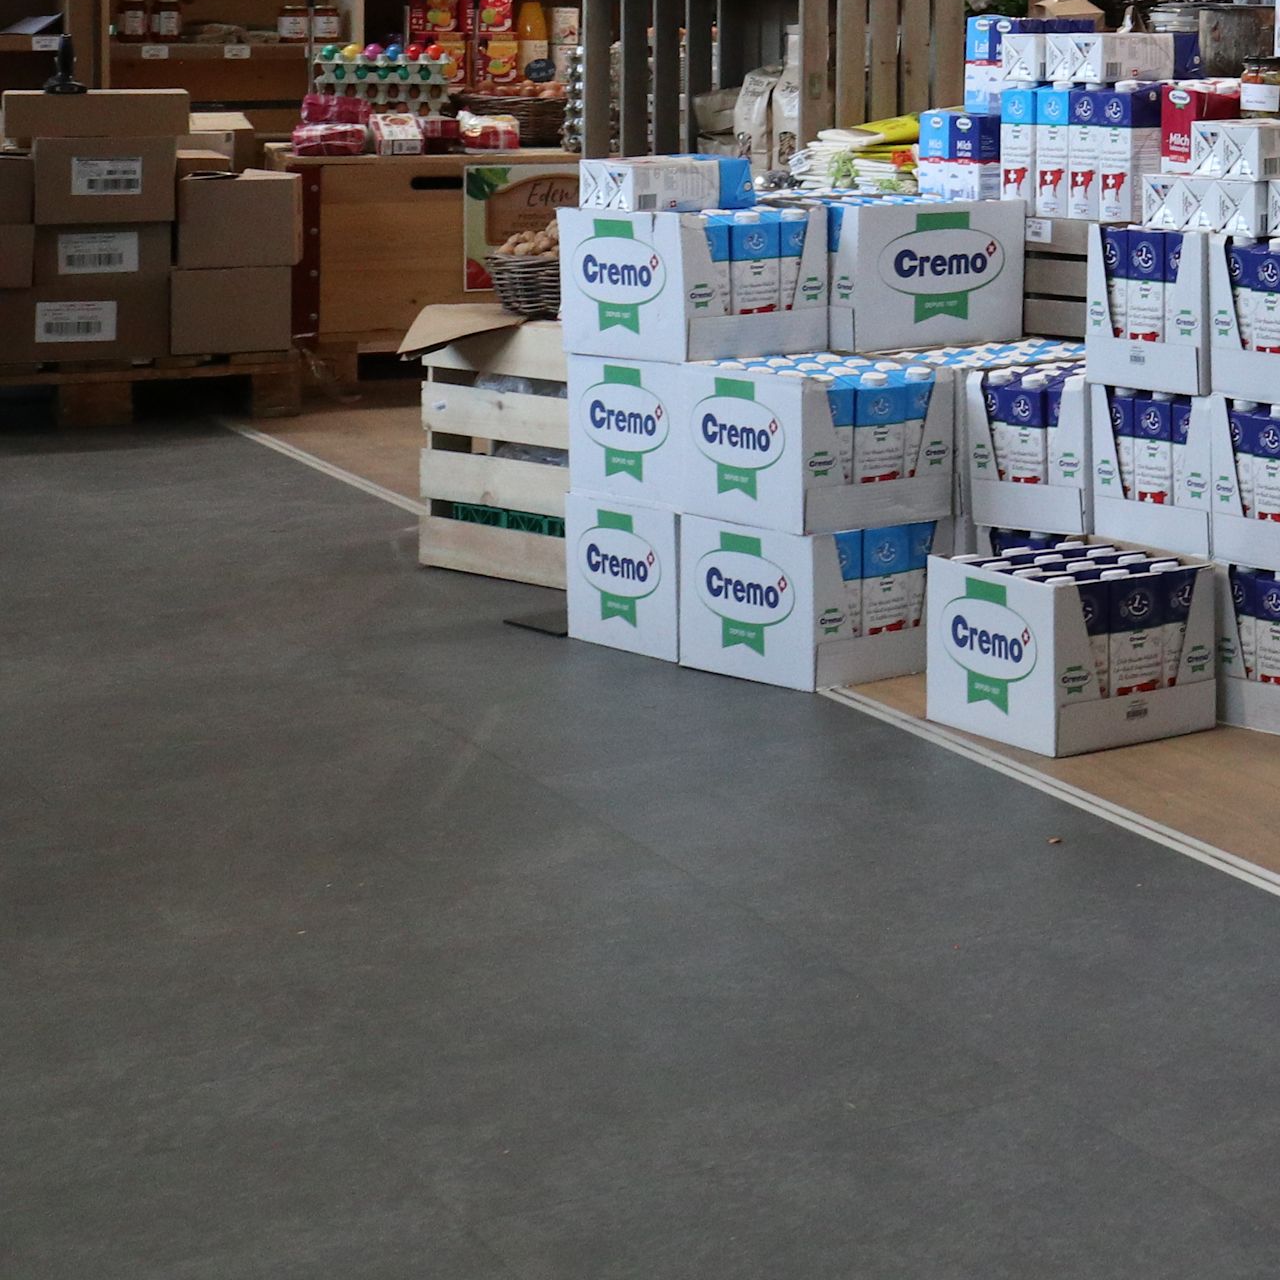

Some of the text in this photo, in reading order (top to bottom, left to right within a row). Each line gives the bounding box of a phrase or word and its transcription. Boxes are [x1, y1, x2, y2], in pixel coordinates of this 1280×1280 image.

[526, 182, 573, 207] Eden
[582, 253, 652, 288] Cremo
[894, 249, 988, 278] Cremo
[590, 400, 656, 437] Cremo
[702, 413, 771, 452] Cremo
[587, 543, 648, 583] Cremo
[706, 567, 779, 609] Cremo
[952, 615, 1024, 663] Cremo
